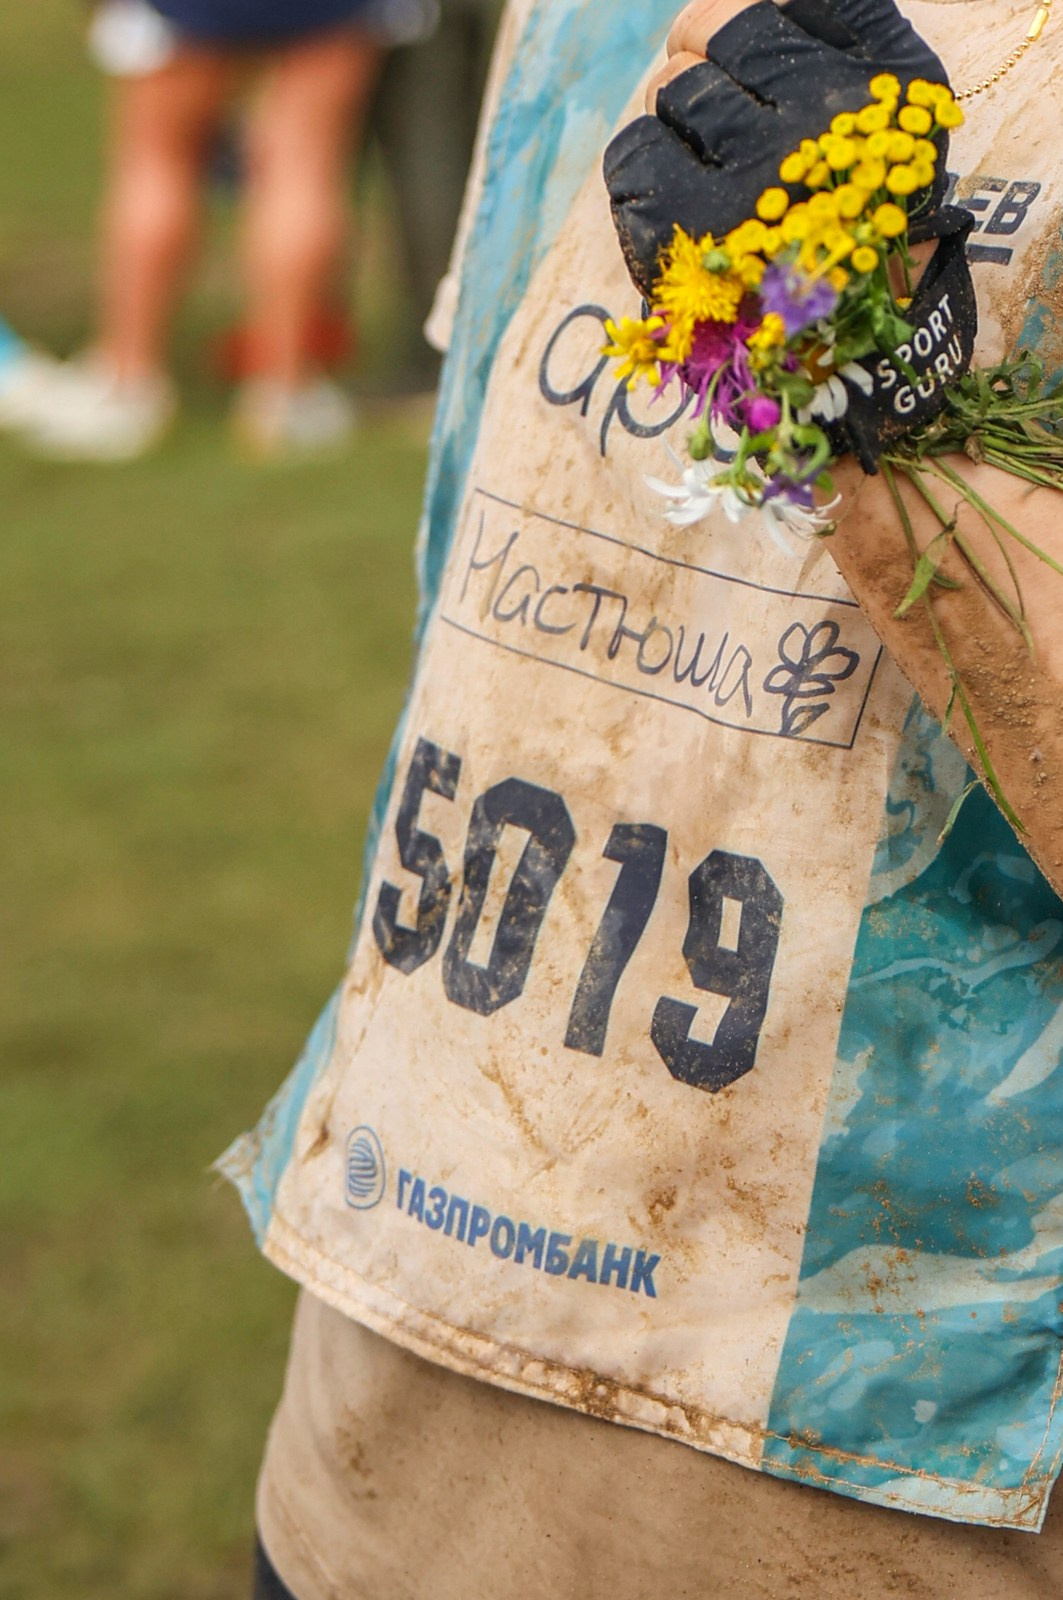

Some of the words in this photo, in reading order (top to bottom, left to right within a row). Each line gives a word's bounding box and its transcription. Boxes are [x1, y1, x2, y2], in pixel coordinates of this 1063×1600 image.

[942, 172, 1042, 235] ЕВ
[876, 293, 953, 389] SPORT
[894, 334, 963, 414] GURU
[459, 509, 753, 718] Настюша
[372, 736, 785, 1094] 5019
[395, 1167, 662, 1299] ГАЗПРОМБАНК
